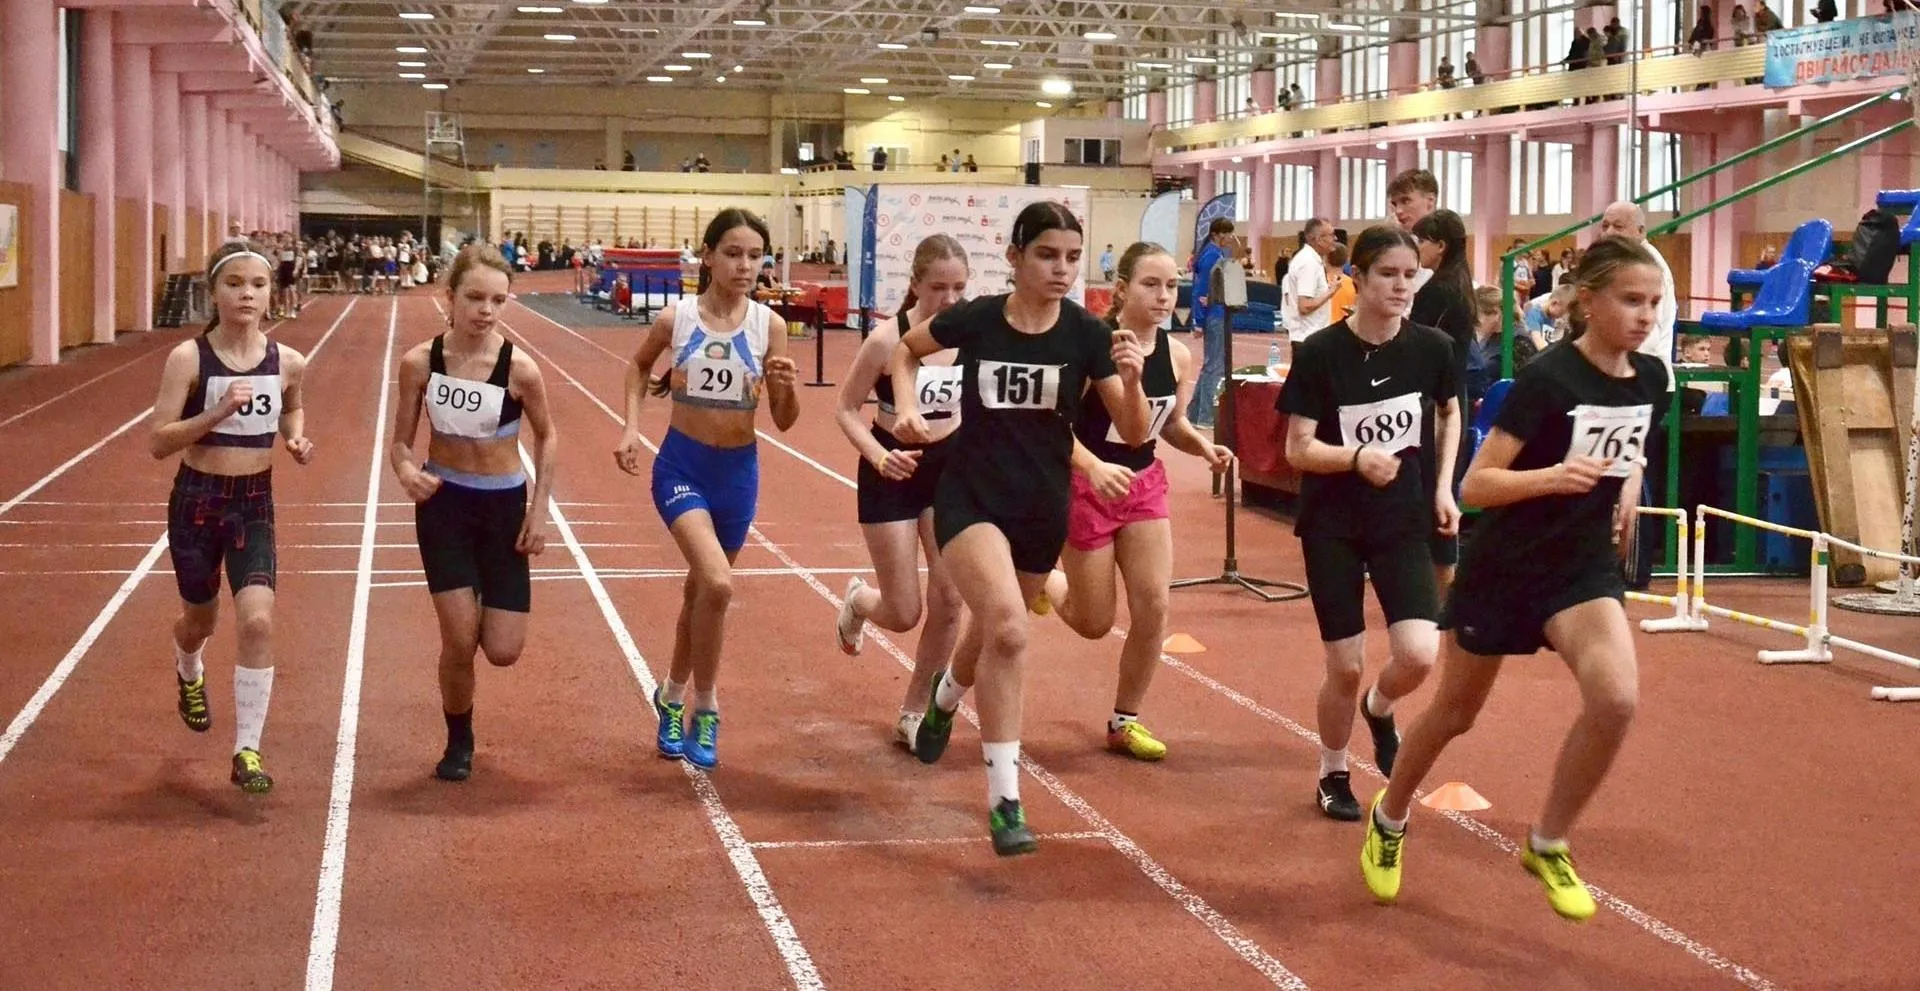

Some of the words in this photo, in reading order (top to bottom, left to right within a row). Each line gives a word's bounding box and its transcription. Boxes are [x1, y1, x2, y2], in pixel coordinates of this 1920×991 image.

[700, 367, 733, 393] 29
[993, 364, 1044, 406] 151
[220, 393, 272, 417] 03
[435, 384, 482, 413] 909
[1355, 409, 1413, 445] 689
[1586, 425, 1644, 462] 765
